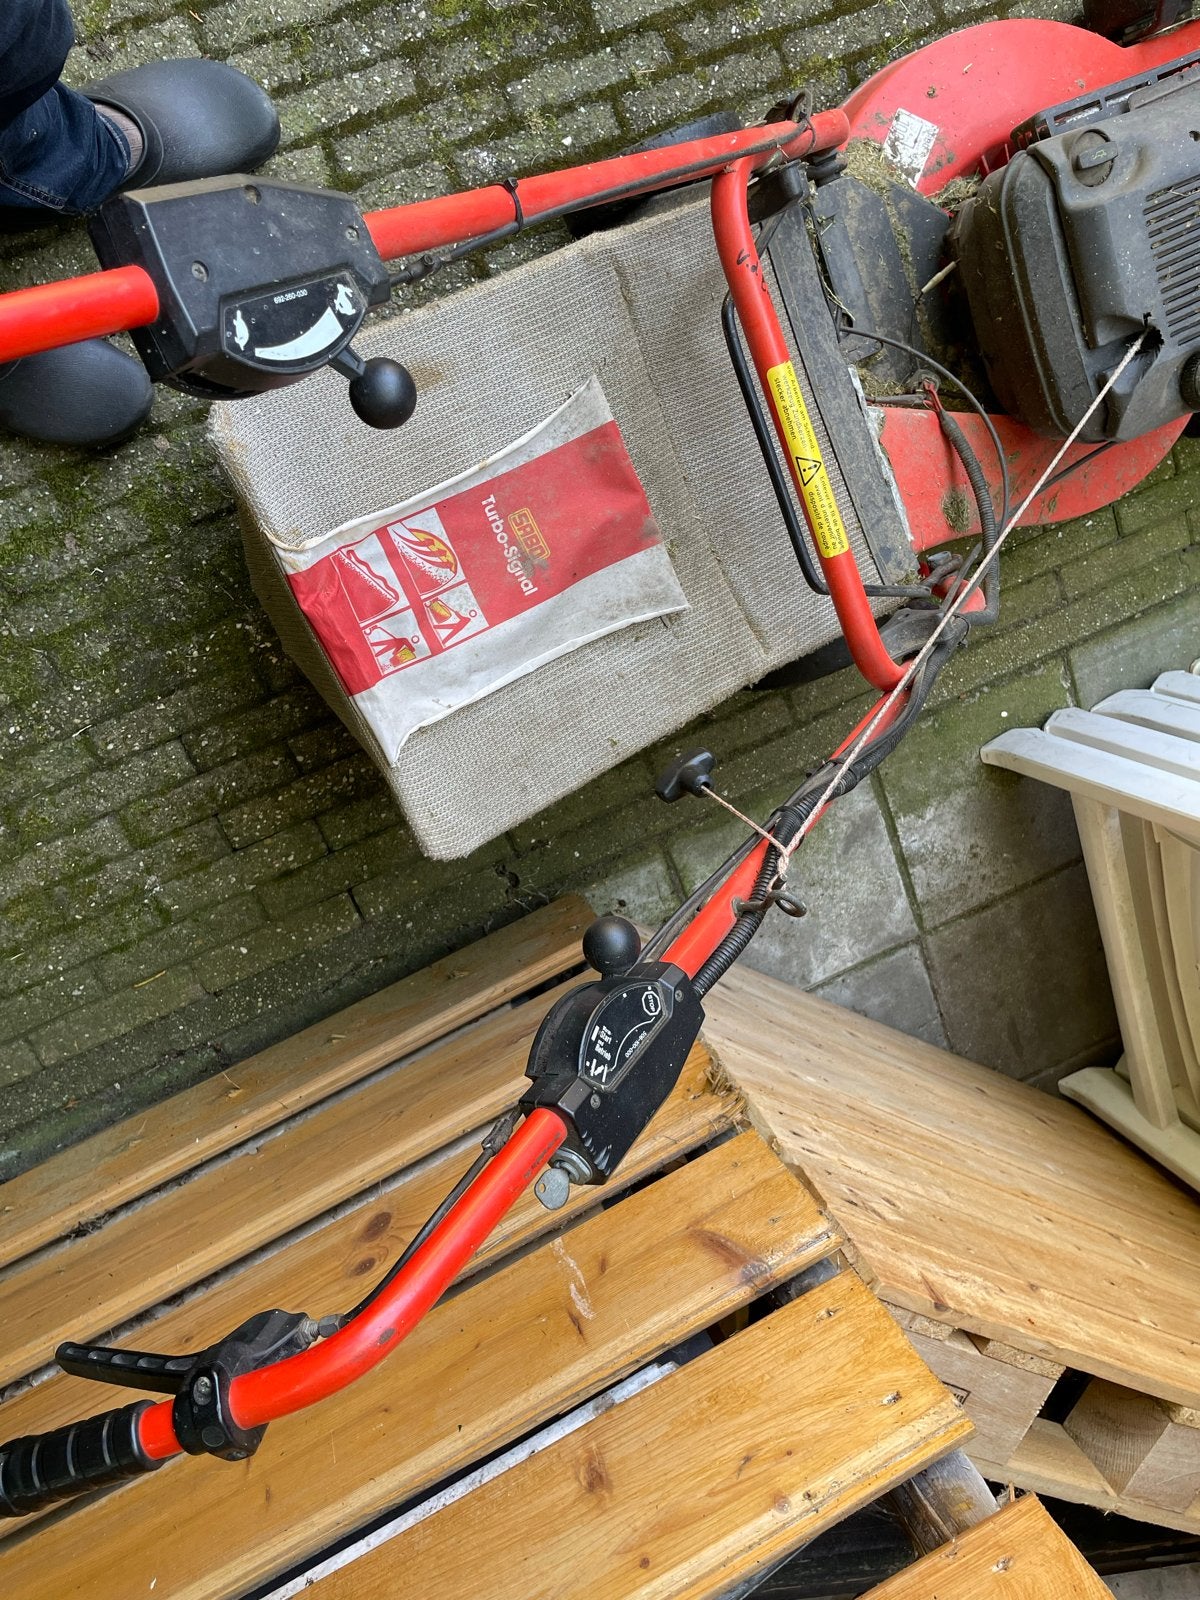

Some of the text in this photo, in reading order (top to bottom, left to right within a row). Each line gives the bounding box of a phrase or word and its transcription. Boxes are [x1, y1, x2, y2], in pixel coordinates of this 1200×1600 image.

[774, 377, 797, 440] stecker abnehmen
[783, 375, 794, 408] werkzeug
[791, 379, 802, 408] Arbeiten
[800, 410, 806, 421] am
[808, 491, 821, 520] dispositif
[817, 521, 824, 530] de
[814, 484, 824, 502] avant
[831, 541, 838, 550] au
[820, 475, 830, 500] Enlever
[832, 518, 839, 527] de
[481, 494, 538, 596] Turbo-Signal
[510, 508, 549, 558] SABO
[647, 994, 656, 1012] STOP
